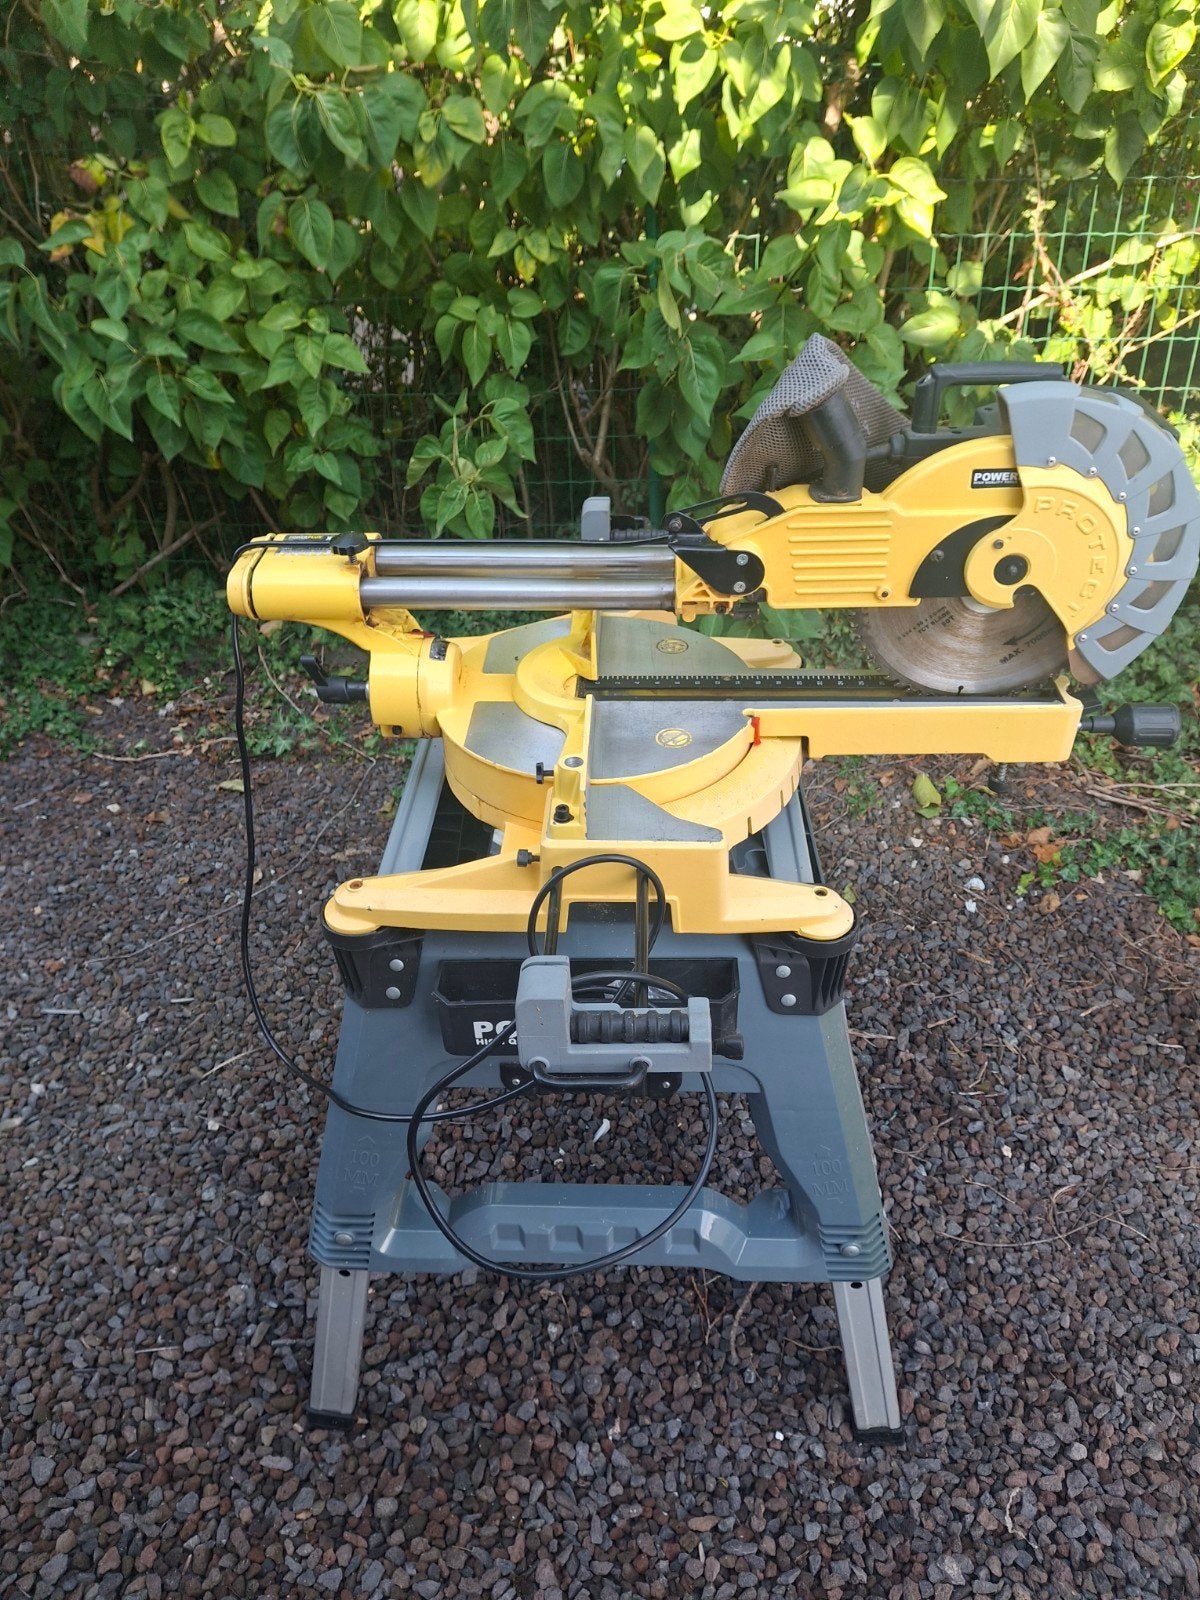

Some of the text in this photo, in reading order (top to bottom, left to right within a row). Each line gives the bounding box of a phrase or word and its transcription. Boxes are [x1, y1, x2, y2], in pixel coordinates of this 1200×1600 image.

[973, 472, 1018, 481] POWER
[1033, 496, 1108, 618] PROTECT
[350, 1149, 380, 1168] 100
[810, 1159, 842, 1177] 100
[811, 1178, 850, 1196] MM
